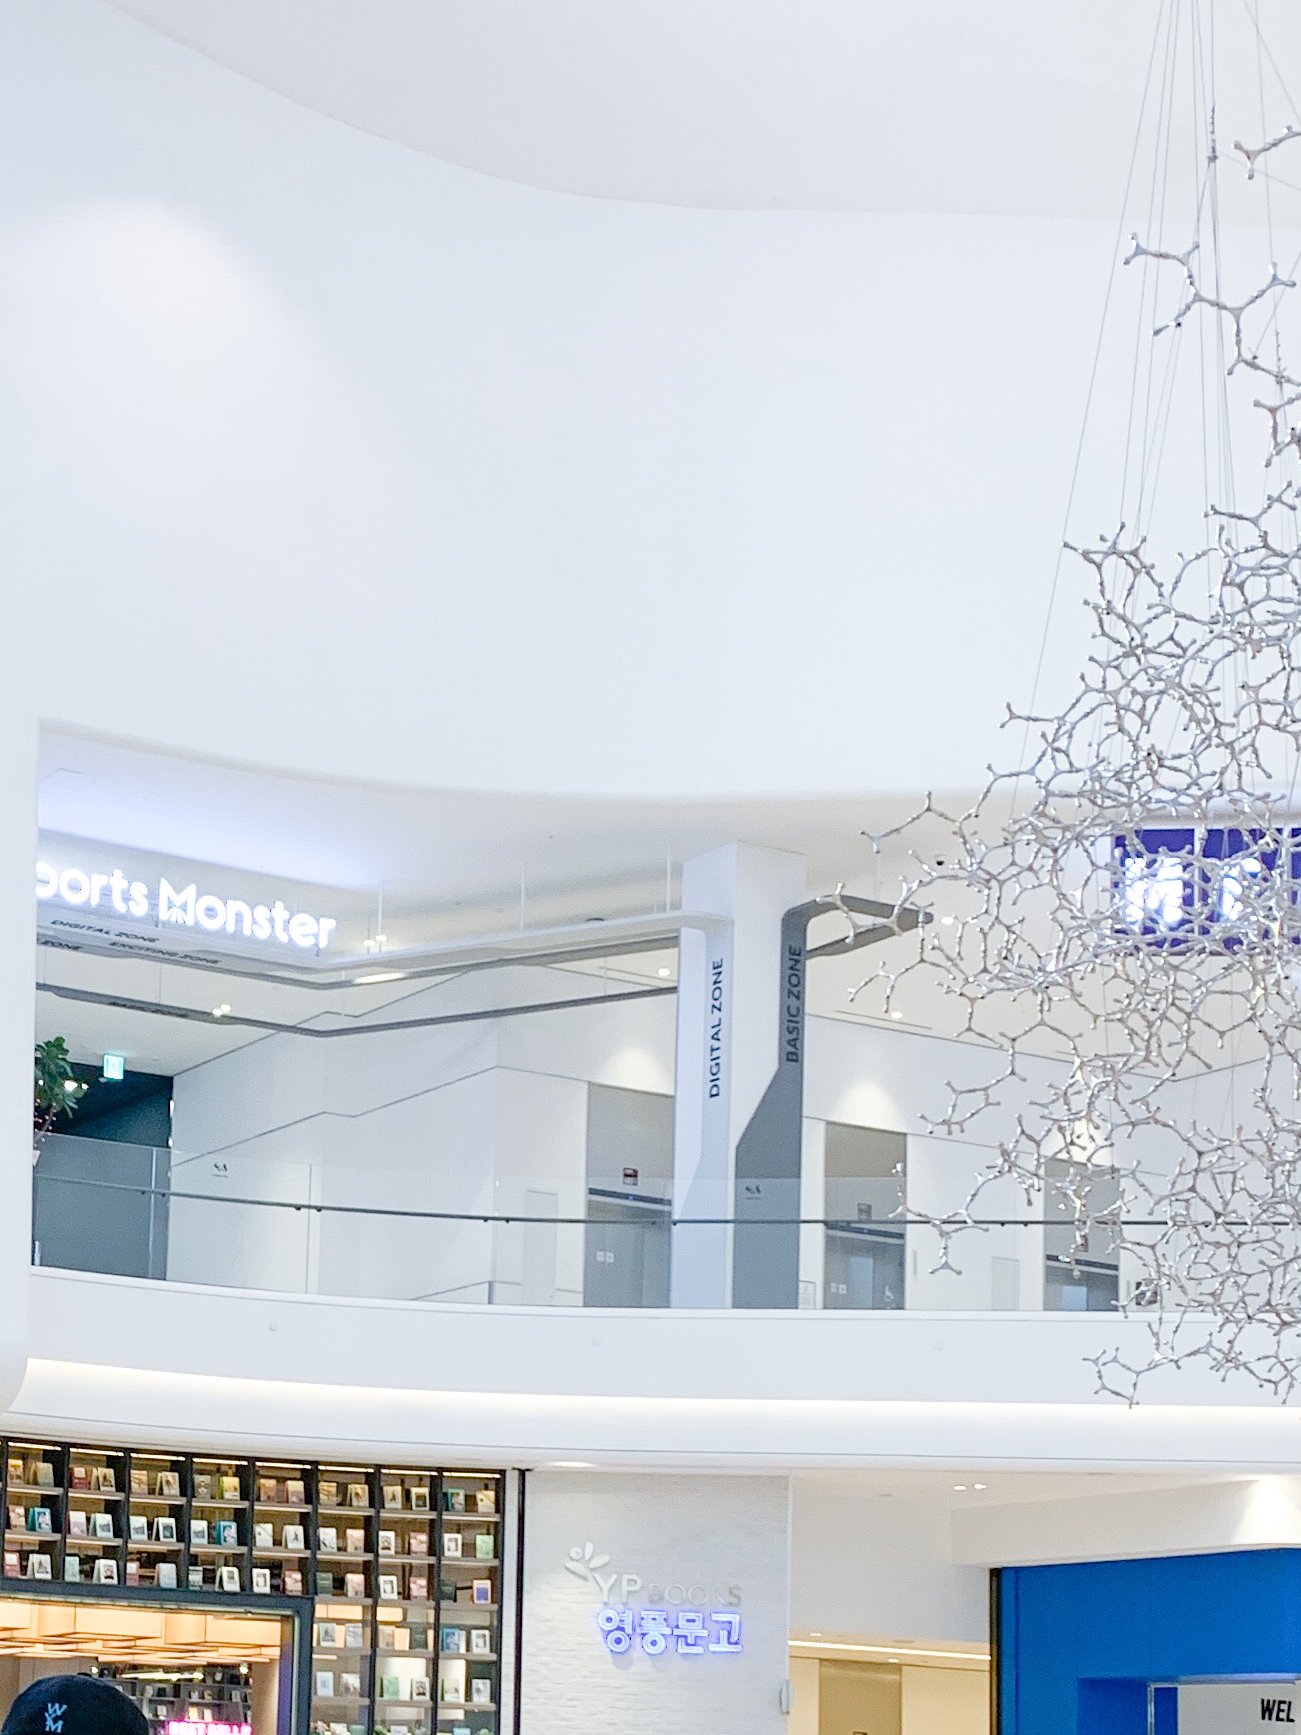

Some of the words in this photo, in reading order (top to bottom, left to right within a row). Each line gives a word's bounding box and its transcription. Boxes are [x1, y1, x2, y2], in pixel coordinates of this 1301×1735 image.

[51, 919, 111, 935] DIGITAL
[114, 931, 160, 943] ZONE
[159, 877, 336, 949] Monster
[711, 958, 724, 1015] ZONE
[788, 945, 802, 1001] ZONE
[709, 1017, 722, 1099] DIGITAL
[786, 1005, 801, 1063] BASIC
[592, 1573, 642, 1604] YP
[648, 1583, 742, 1607] BOOS
[597, 1609, 743, 1655] 영풍문고
[1261, 1698, 1295, 1722] WEL
